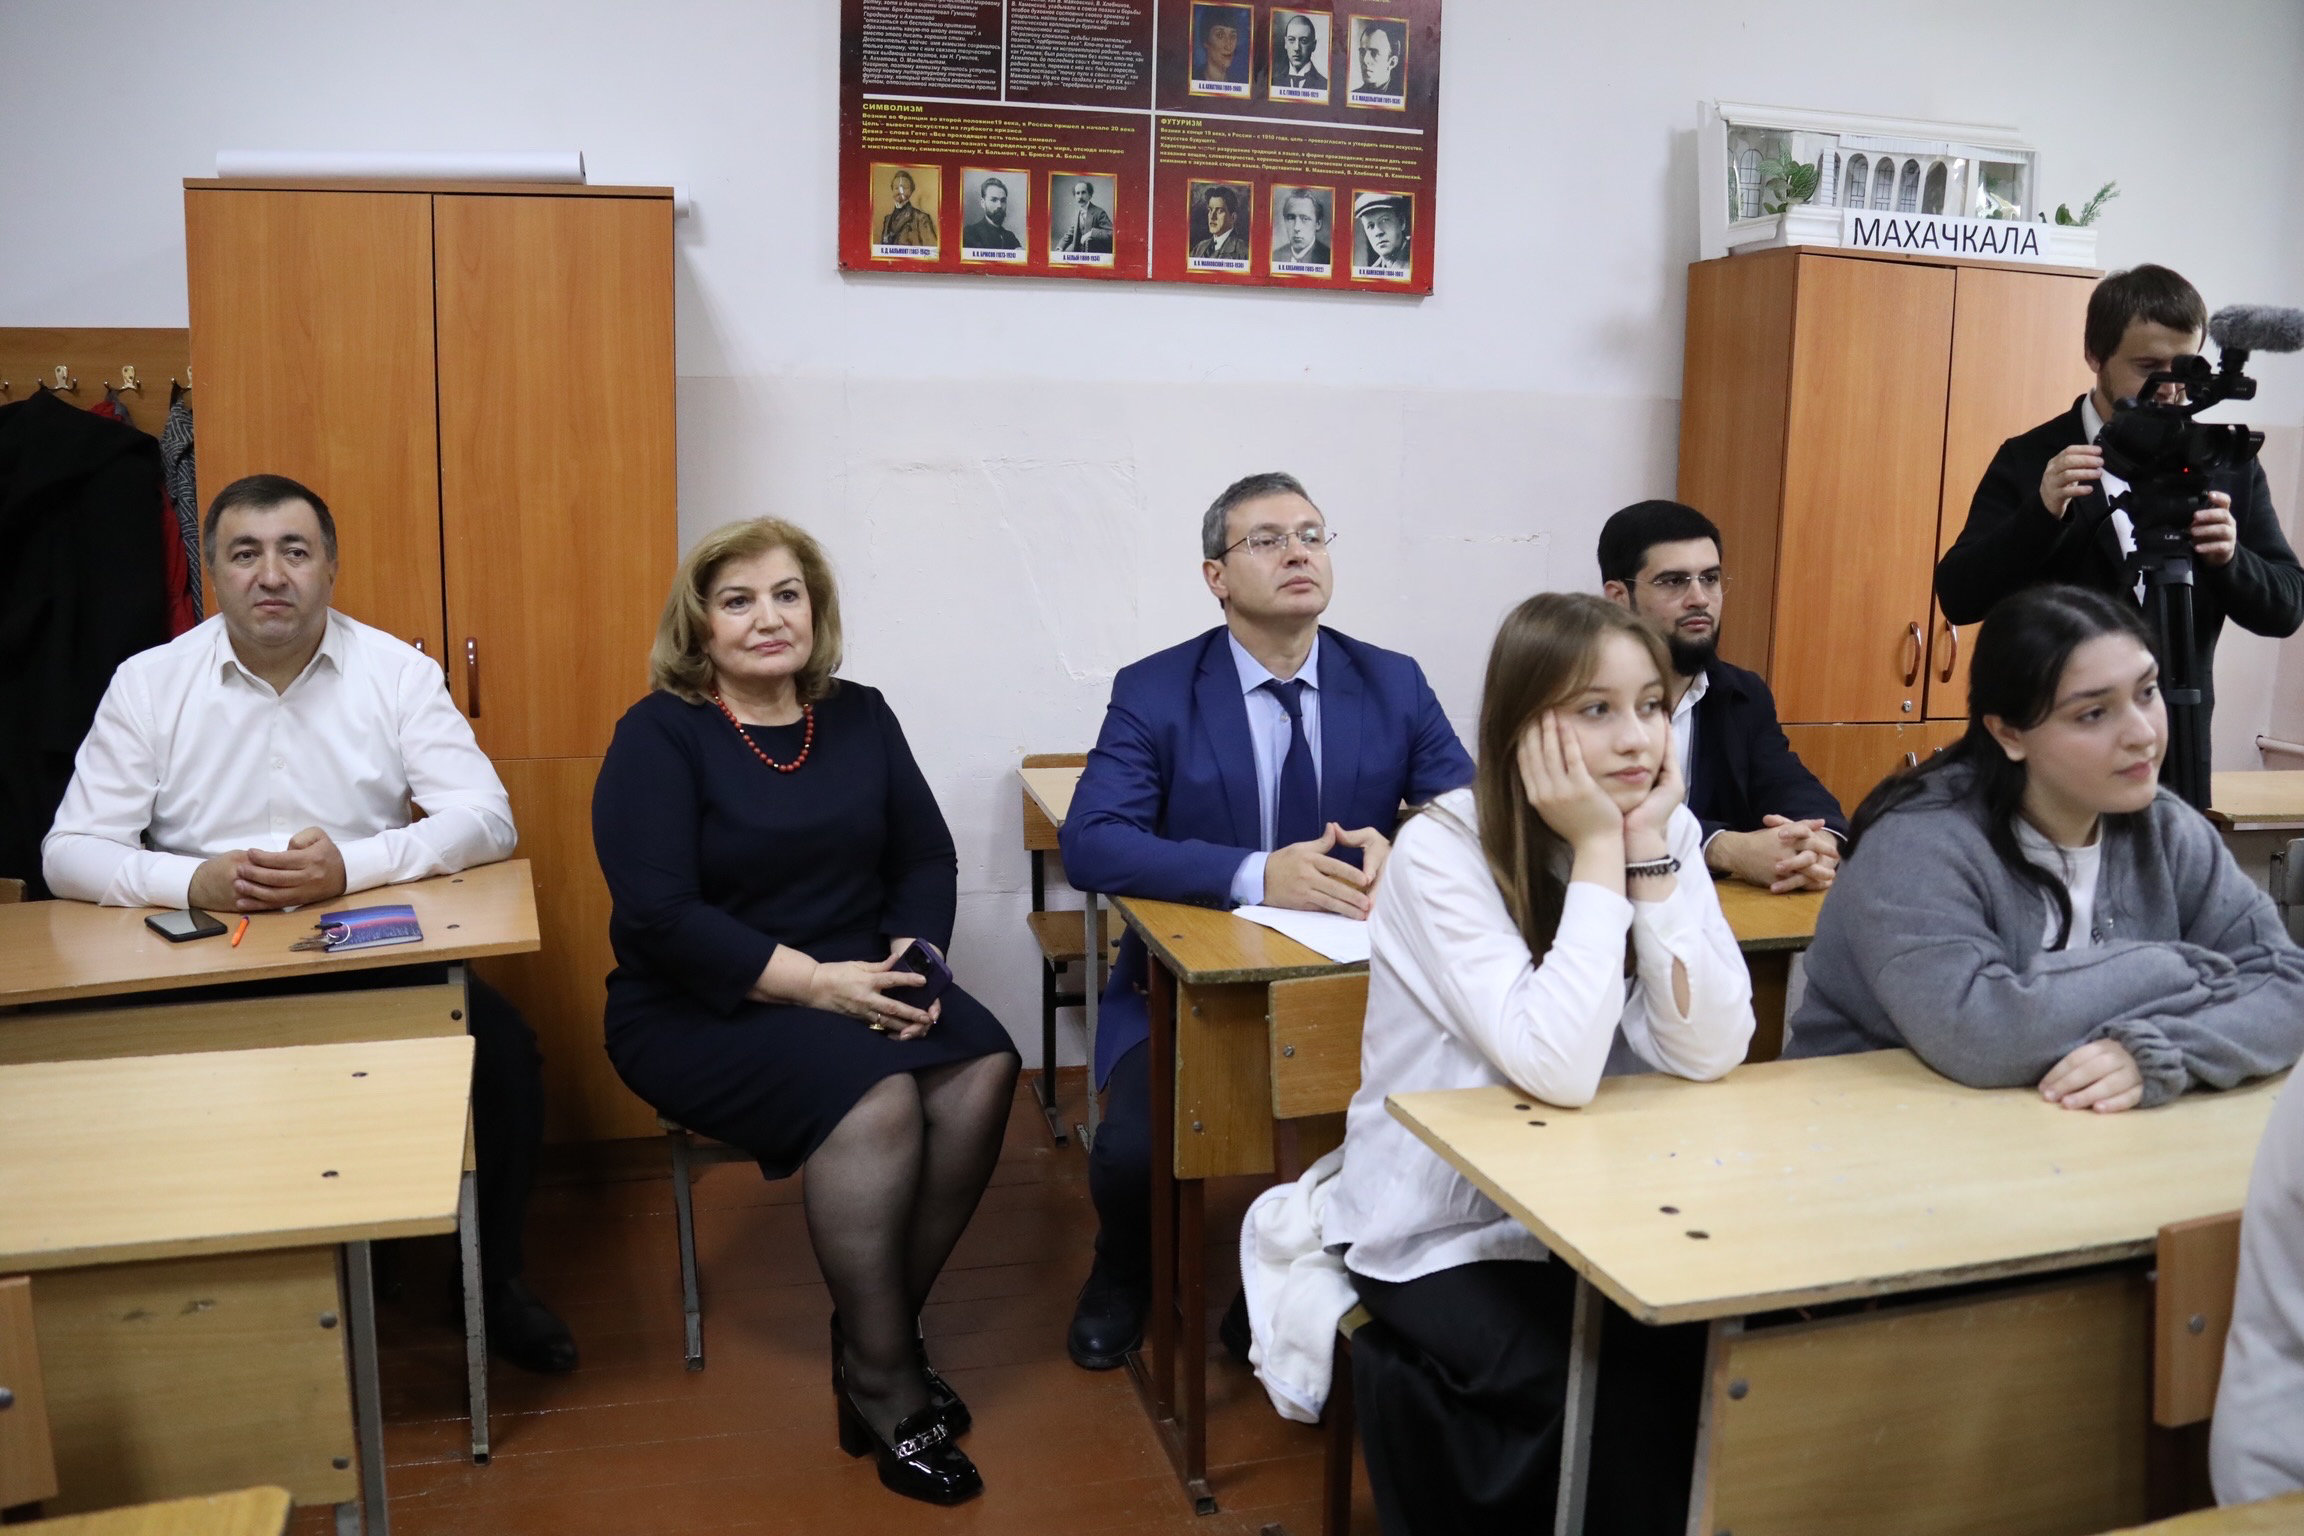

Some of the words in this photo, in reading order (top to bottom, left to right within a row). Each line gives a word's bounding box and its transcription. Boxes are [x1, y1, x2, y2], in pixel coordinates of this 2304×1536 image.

[863, 103, 923, 112] СИМВОЛИЗМ
[1161, 118, 1202, 126] ФУТУРИЗМ
[1853, 217, 2039, 256] МАХАЧКАЛА
